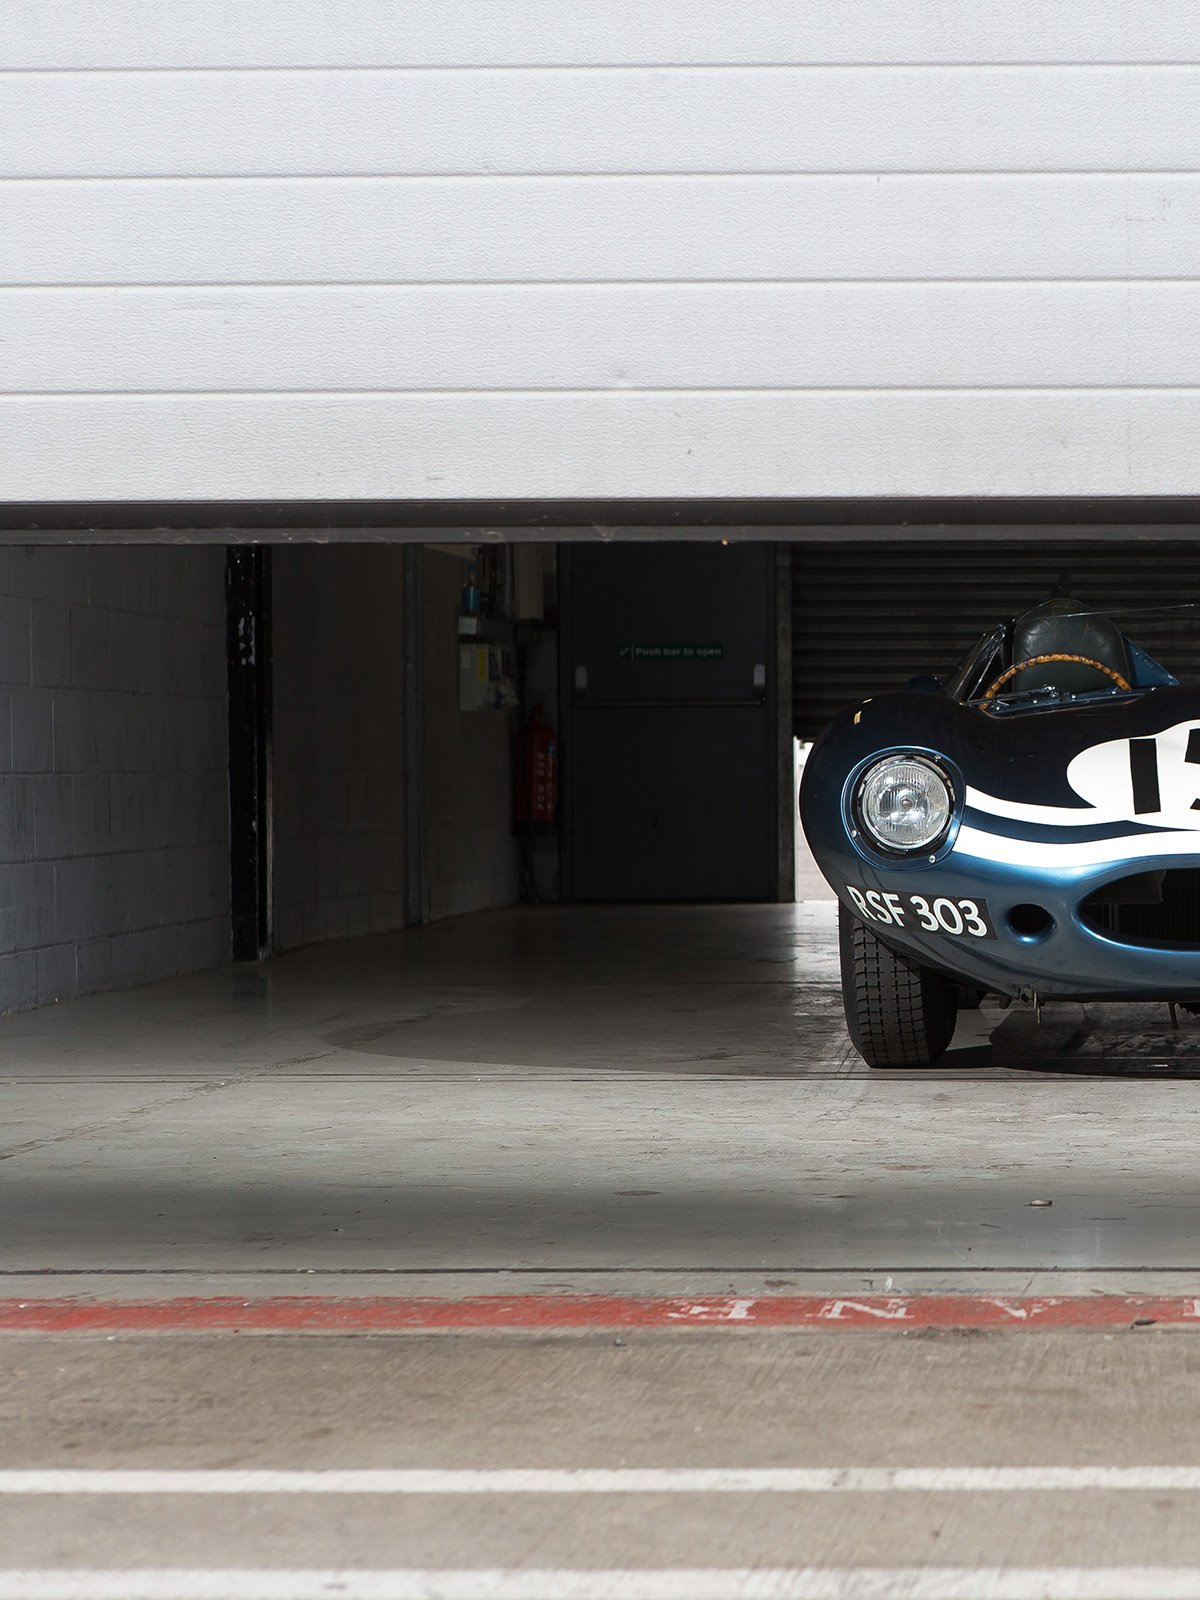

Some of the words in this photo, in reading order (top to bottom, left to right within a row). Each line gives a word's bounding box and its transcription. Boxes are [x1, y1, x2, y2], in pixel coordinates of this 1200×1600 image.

[635, 647, 661, 656] Push
[663, 647, 680, 656] bar
[683, 647, 694, 656] to
[696, 648, 722, 658] open
[846, 885, 905, 927] RSF
[909, 895, 988, 937] 303
